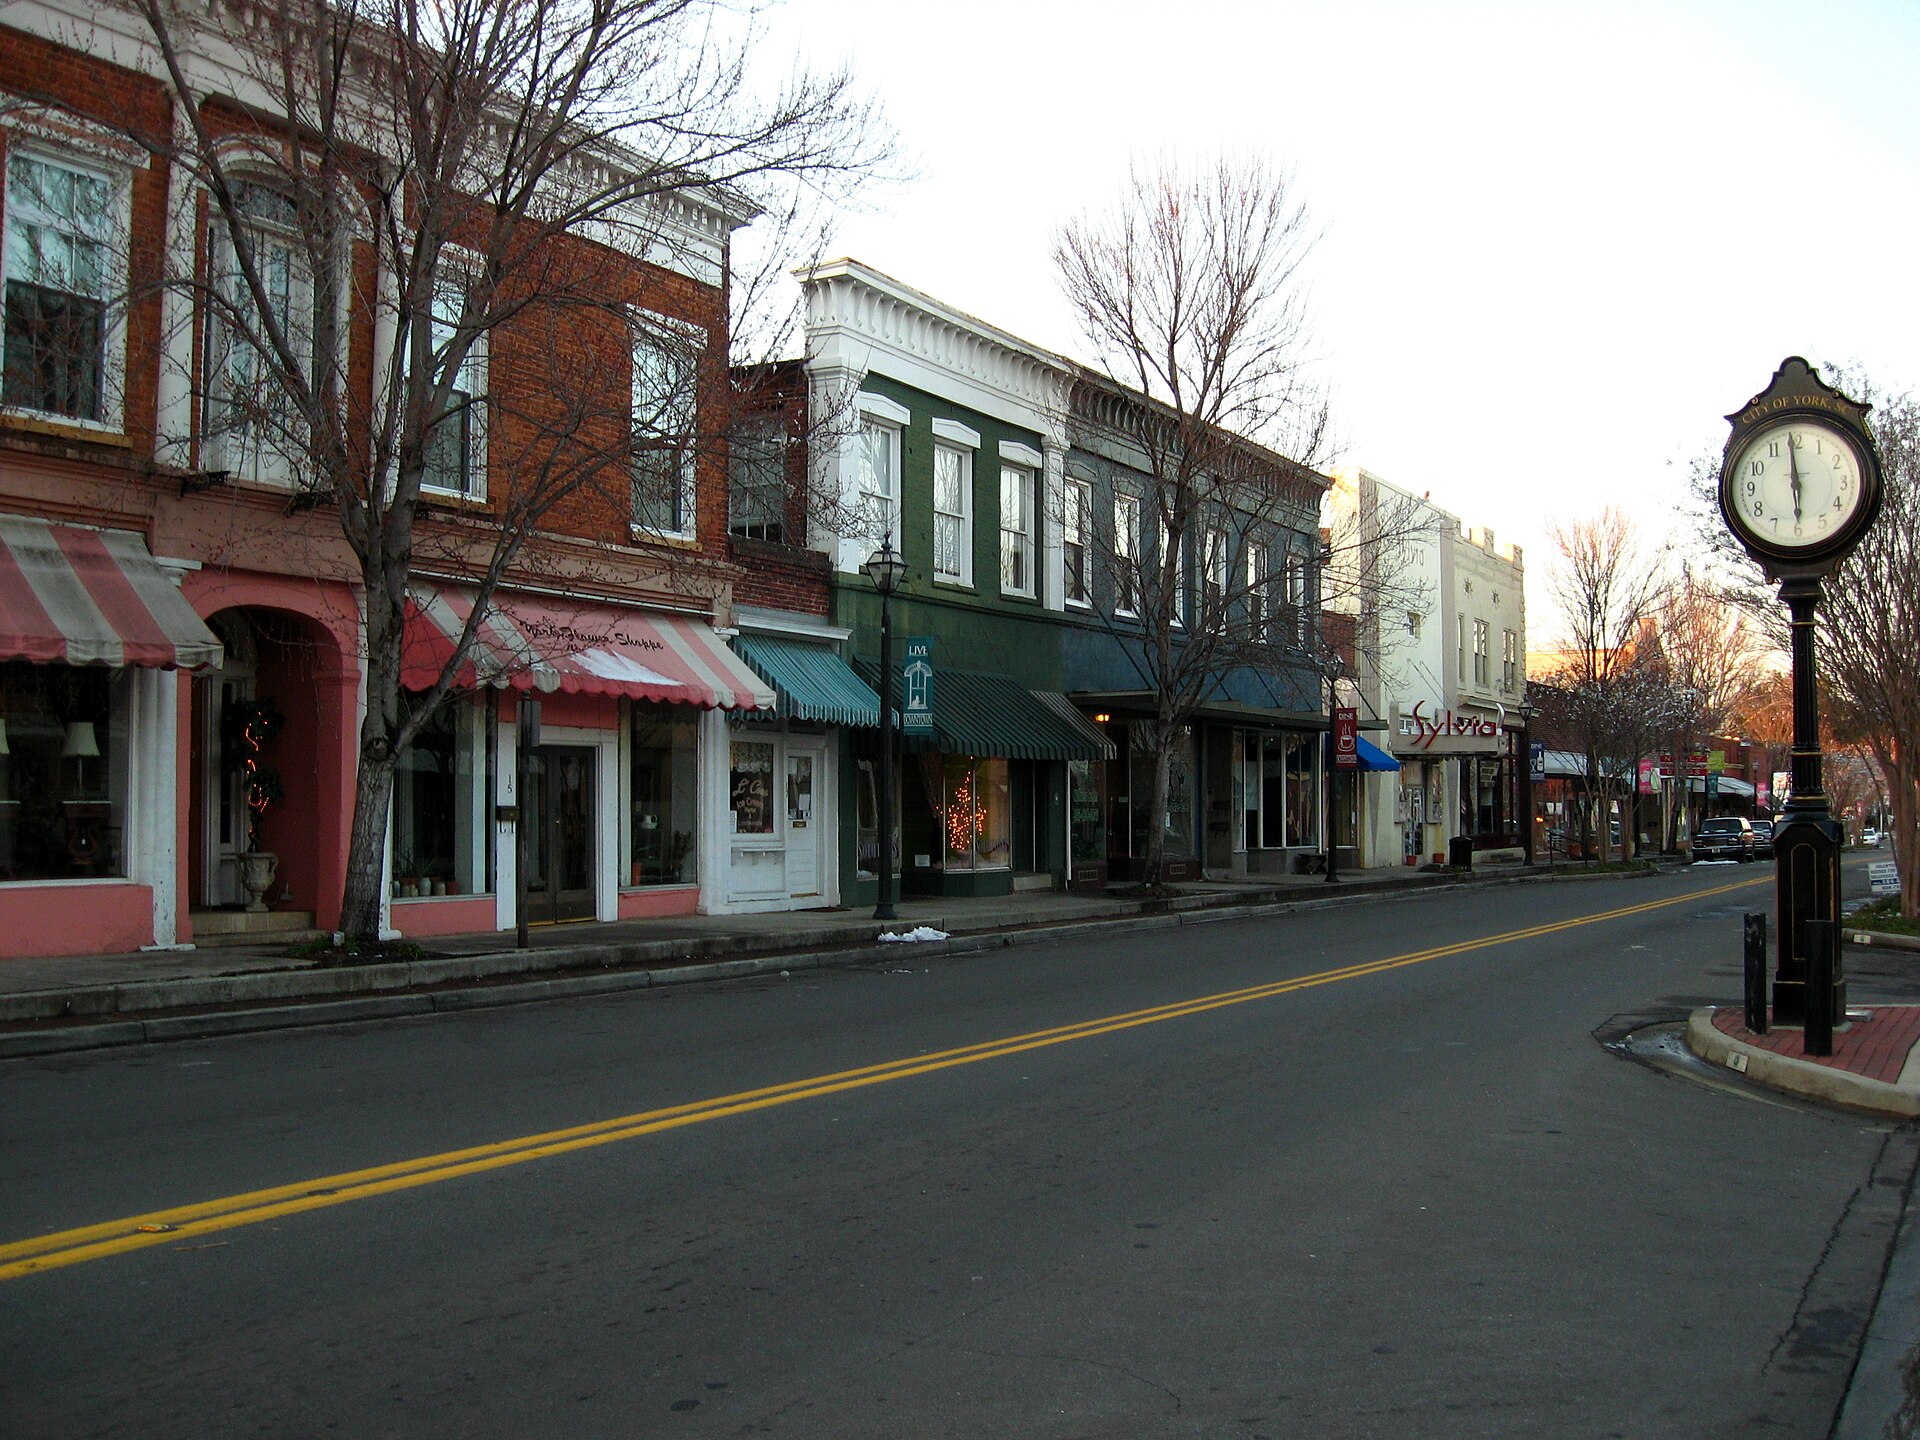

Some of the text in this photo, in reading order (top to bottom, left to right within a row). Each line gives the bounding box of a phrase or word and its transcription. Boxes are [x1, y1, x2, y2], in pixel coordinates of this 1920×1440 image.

[1742, 402, 1768, 423] CITY
[1773, 397, 1789, 409] OF
[1835, 402, 1850, 415] SC
[1768, 440, 1821, 457] 11 1
[1751, 455, 1840, 476] 10 2
[1747, 475, 1847, 496] 9 3
[1754, 496, 1842, 517] 8 4
[1769, 514, 1827, 537] 7 6 5
[615, 633, 663, 651] Shoppe
[909, 645, 928, 655] LIVE
[1411, 700, 1496, 750] Sylvia
